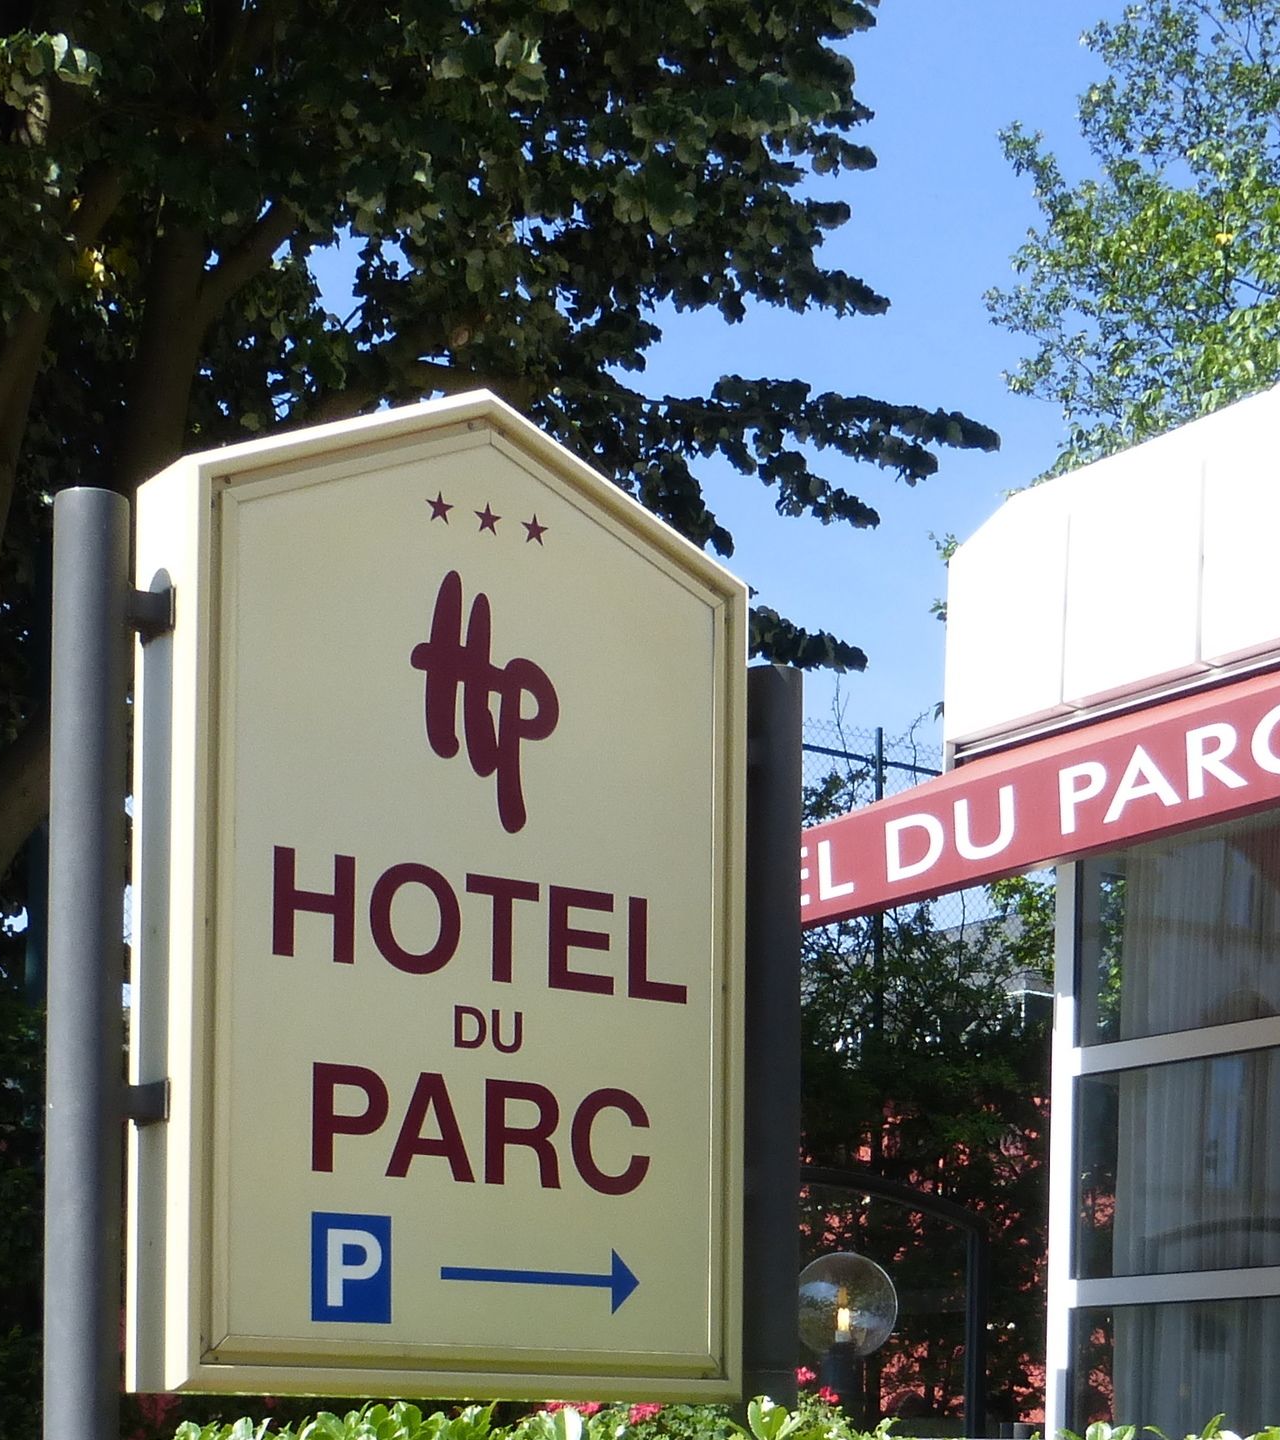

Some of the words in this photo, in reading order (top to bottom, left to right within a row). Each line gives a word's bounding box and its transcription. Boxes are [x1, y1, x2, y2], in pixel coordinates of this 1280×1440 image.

[885, 785, 1016, 883] DU
[272, 845, 688, 1005] HOTEL
[453, 1005, 523, 1054] DU
[311, 1061, 651, 1196] PARC
[326, 1227, 383, 1307] P
